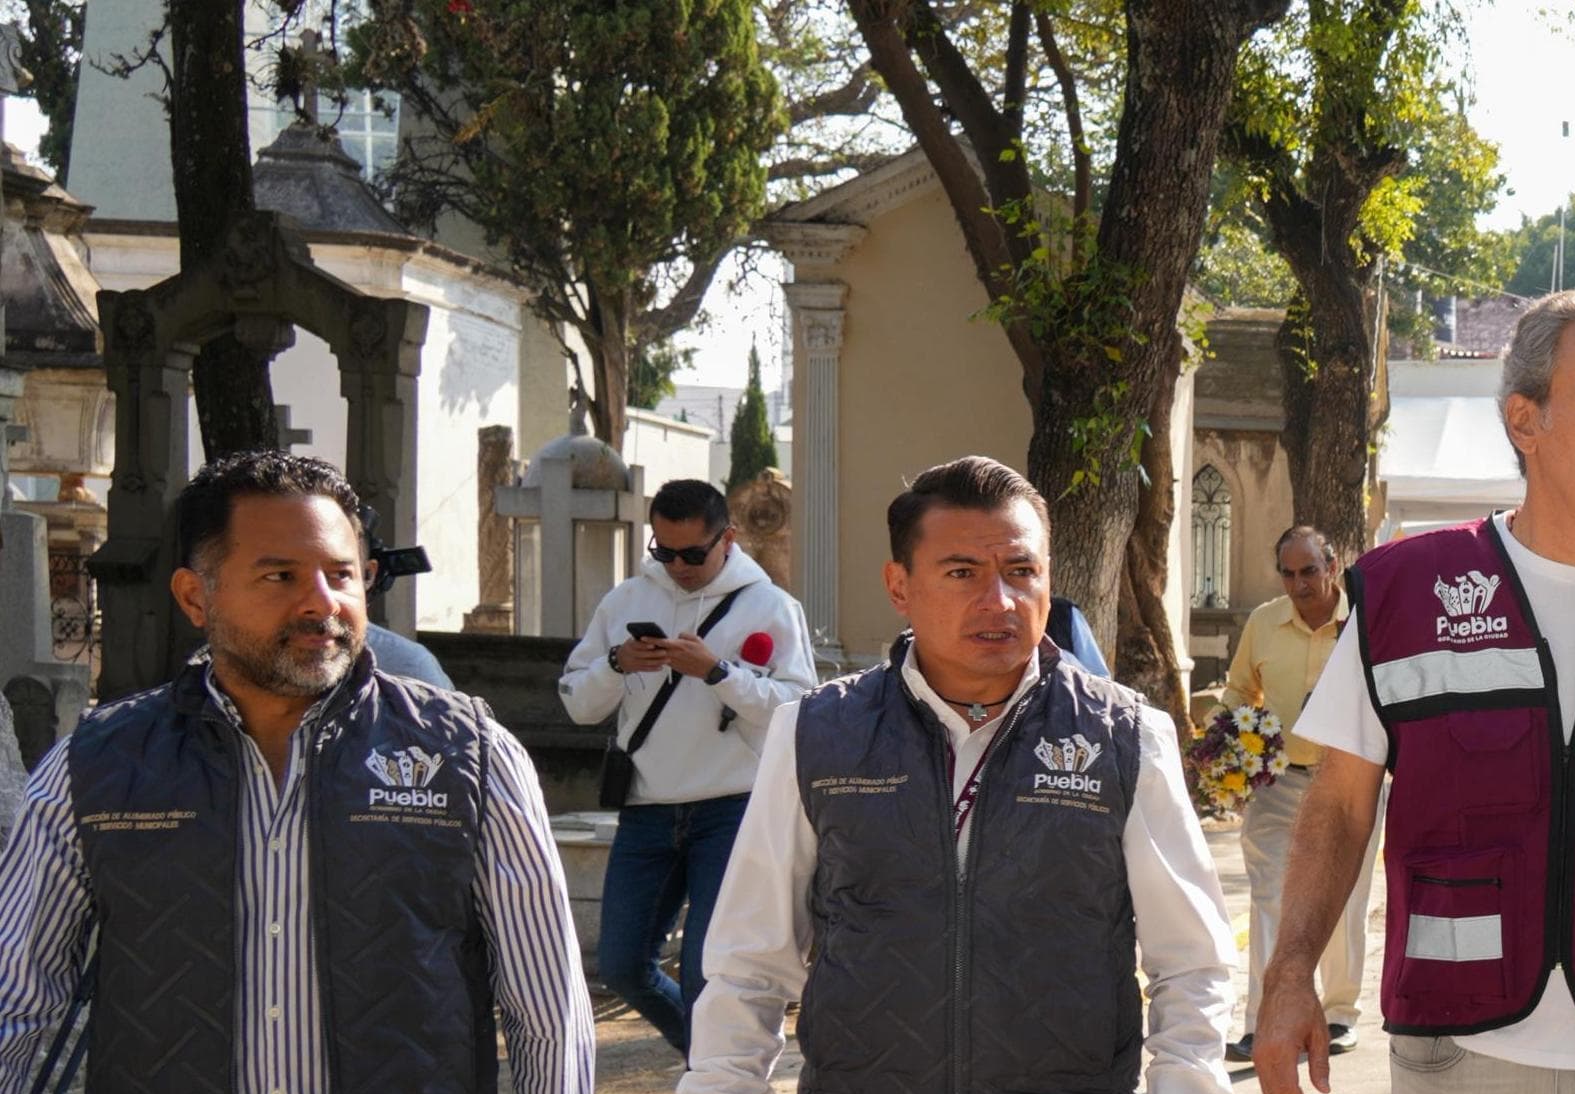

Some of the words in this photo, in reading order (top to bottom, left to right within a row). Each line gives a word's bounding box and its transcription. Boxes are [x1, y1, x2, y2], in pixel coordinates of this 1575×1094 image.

[1437, 616, 1507, 636] Puebla
[1034, 773, 1101, 793] Puebla
[369, 788, 448, 807] Puebla
